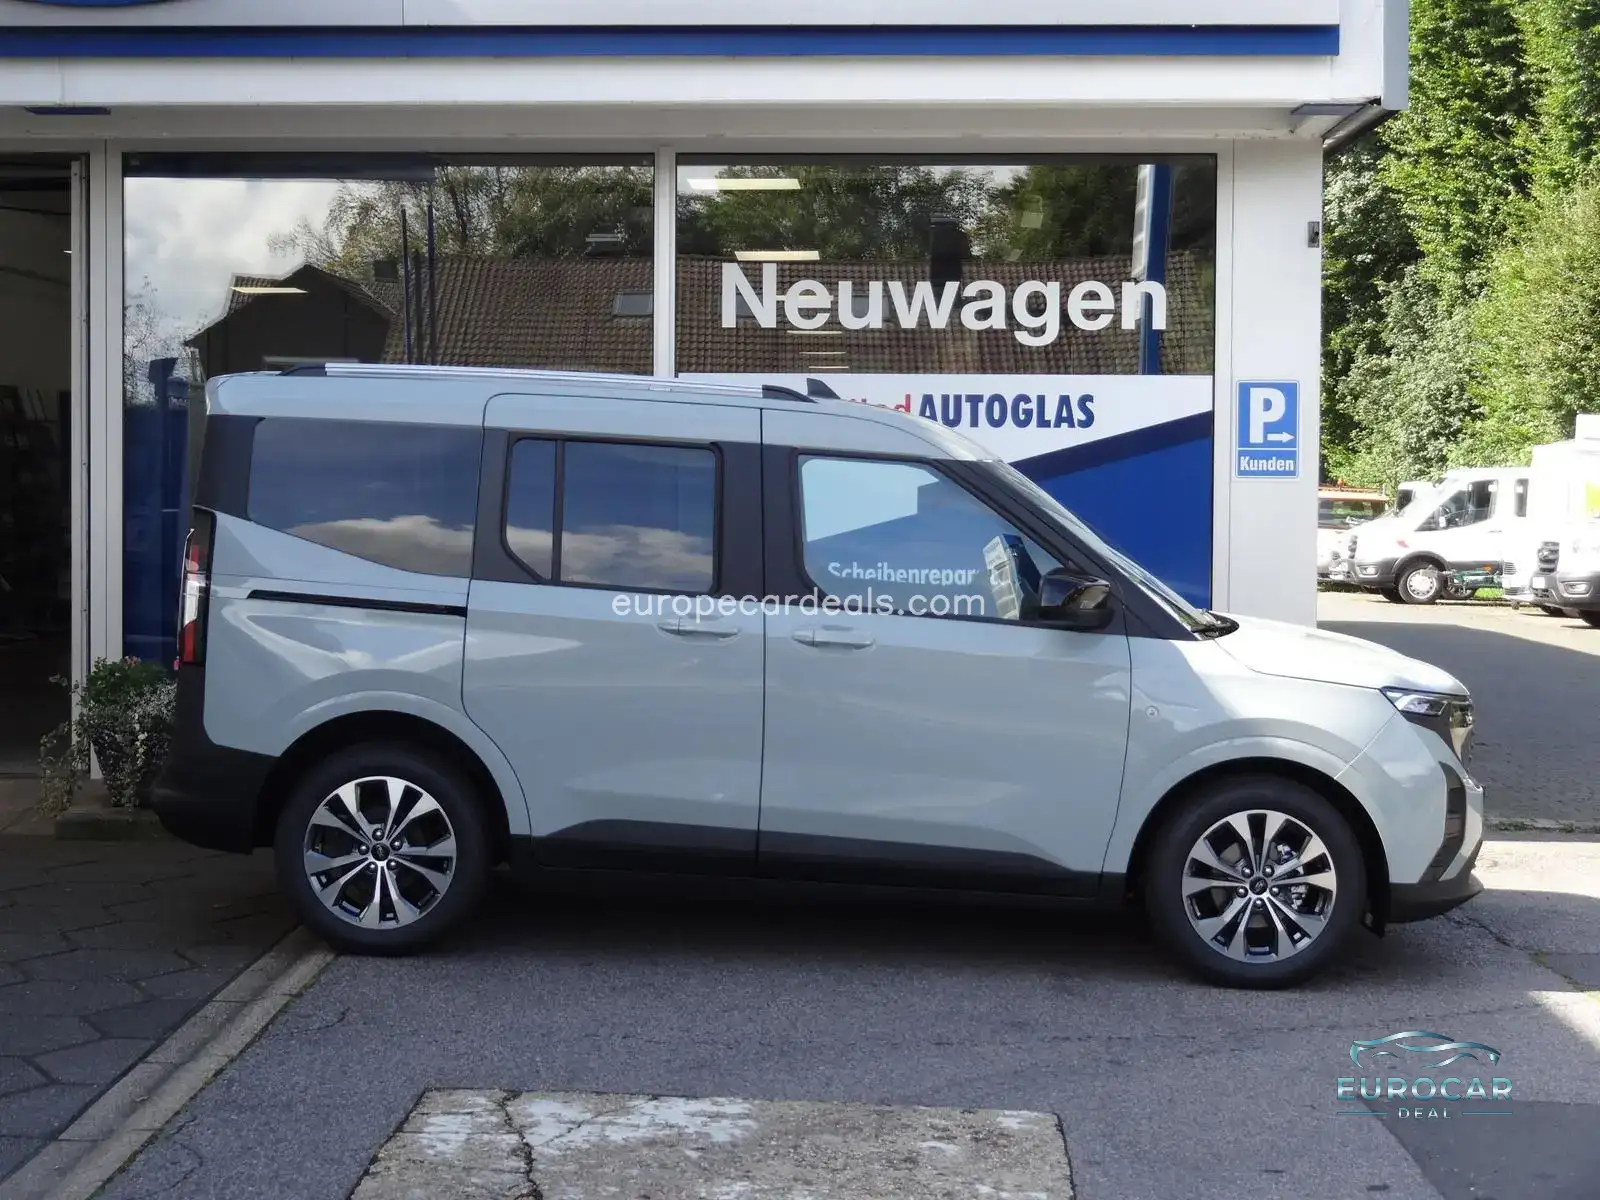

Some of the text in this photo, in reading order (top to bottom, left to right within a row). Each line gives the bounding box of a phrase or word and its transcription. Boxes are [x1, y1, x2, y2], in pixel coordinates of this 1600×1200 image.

[721, 262, 1167, 347] Neuwagen
[918, 393, 1095, 429] AUTOGLAS
[1249, 387, 1286, 443] P
[1240, 456, 1294, 471] Kunden
[828, 561, 979, 586] Scheibenrepar
